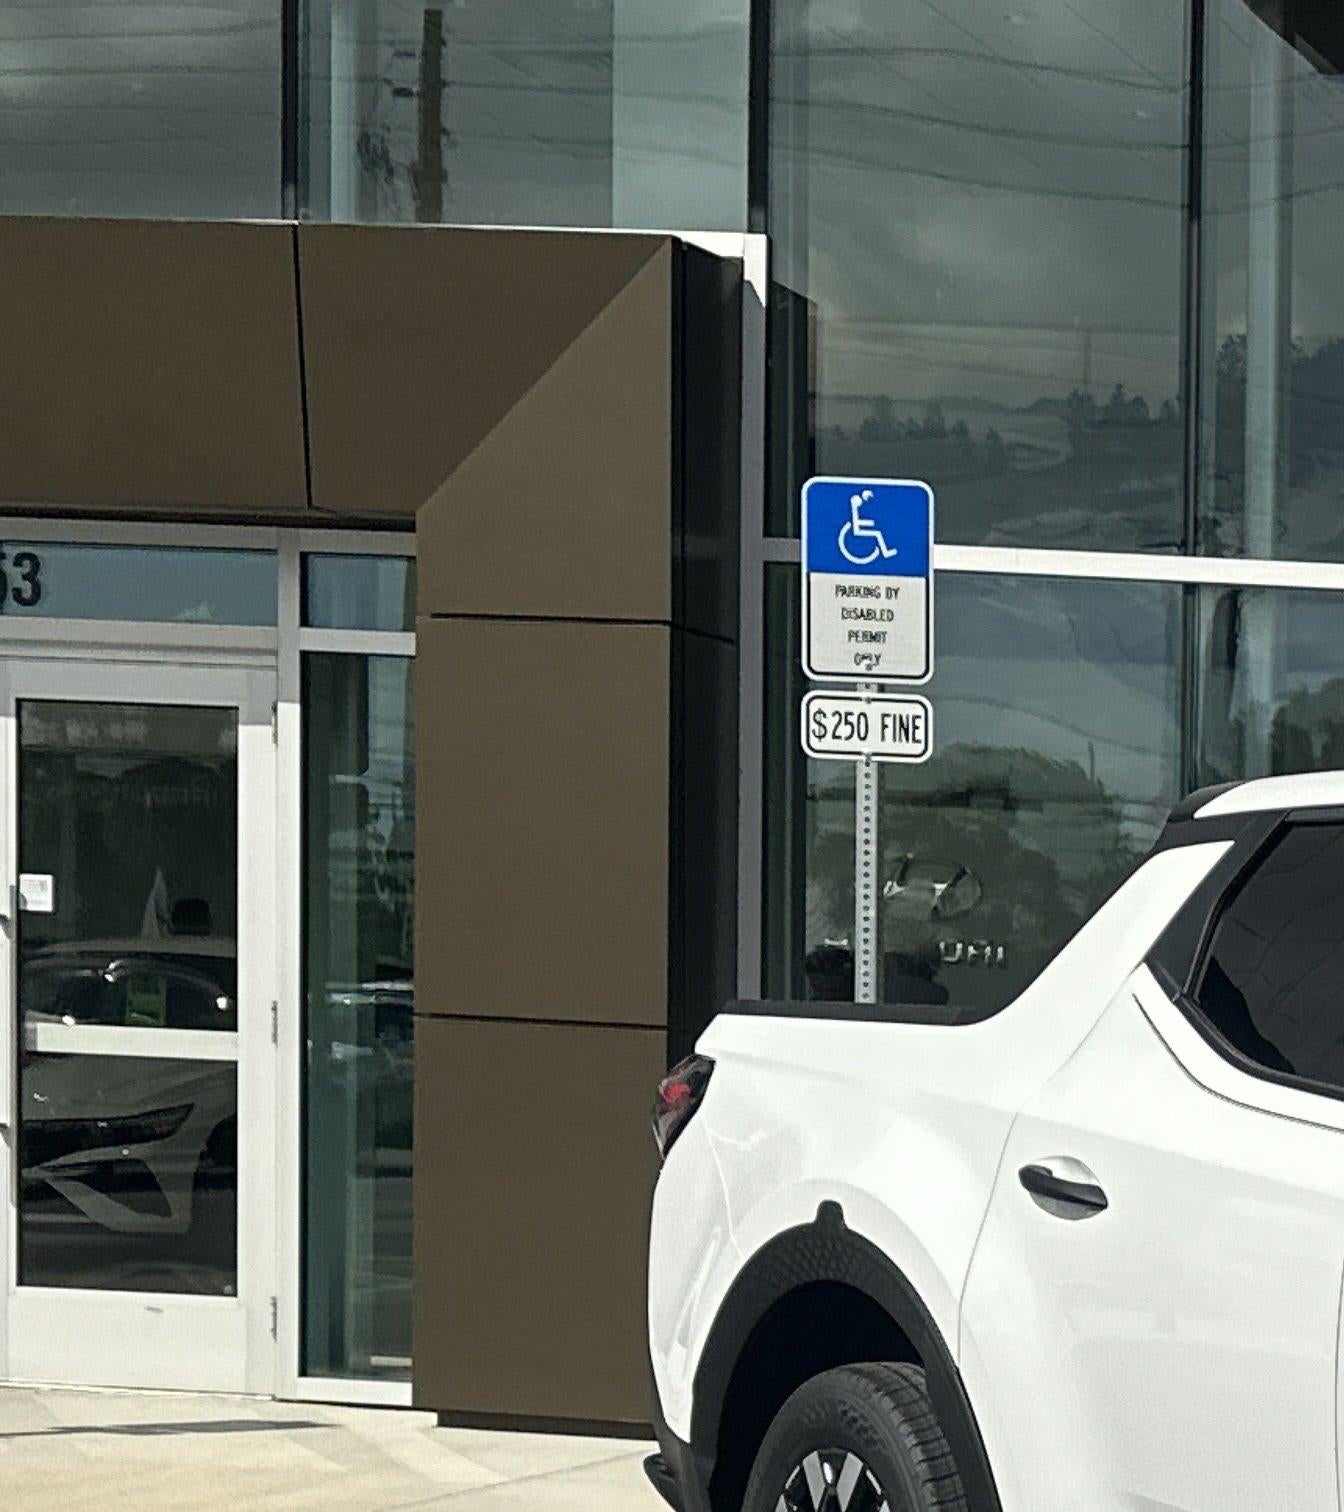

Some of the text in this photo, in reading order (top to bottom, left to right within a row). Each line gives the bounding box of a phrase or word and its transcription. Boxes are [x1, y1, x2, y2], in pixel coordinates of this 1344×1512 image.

[0, 552, 41, 607] 3
[835, 584, 900, 600] PARKING BY
[841, 607, 894, 622] DISABLED
[848, 630, 887, 645] PERMIT
[812, 707, 922, 744] $250 FINE
